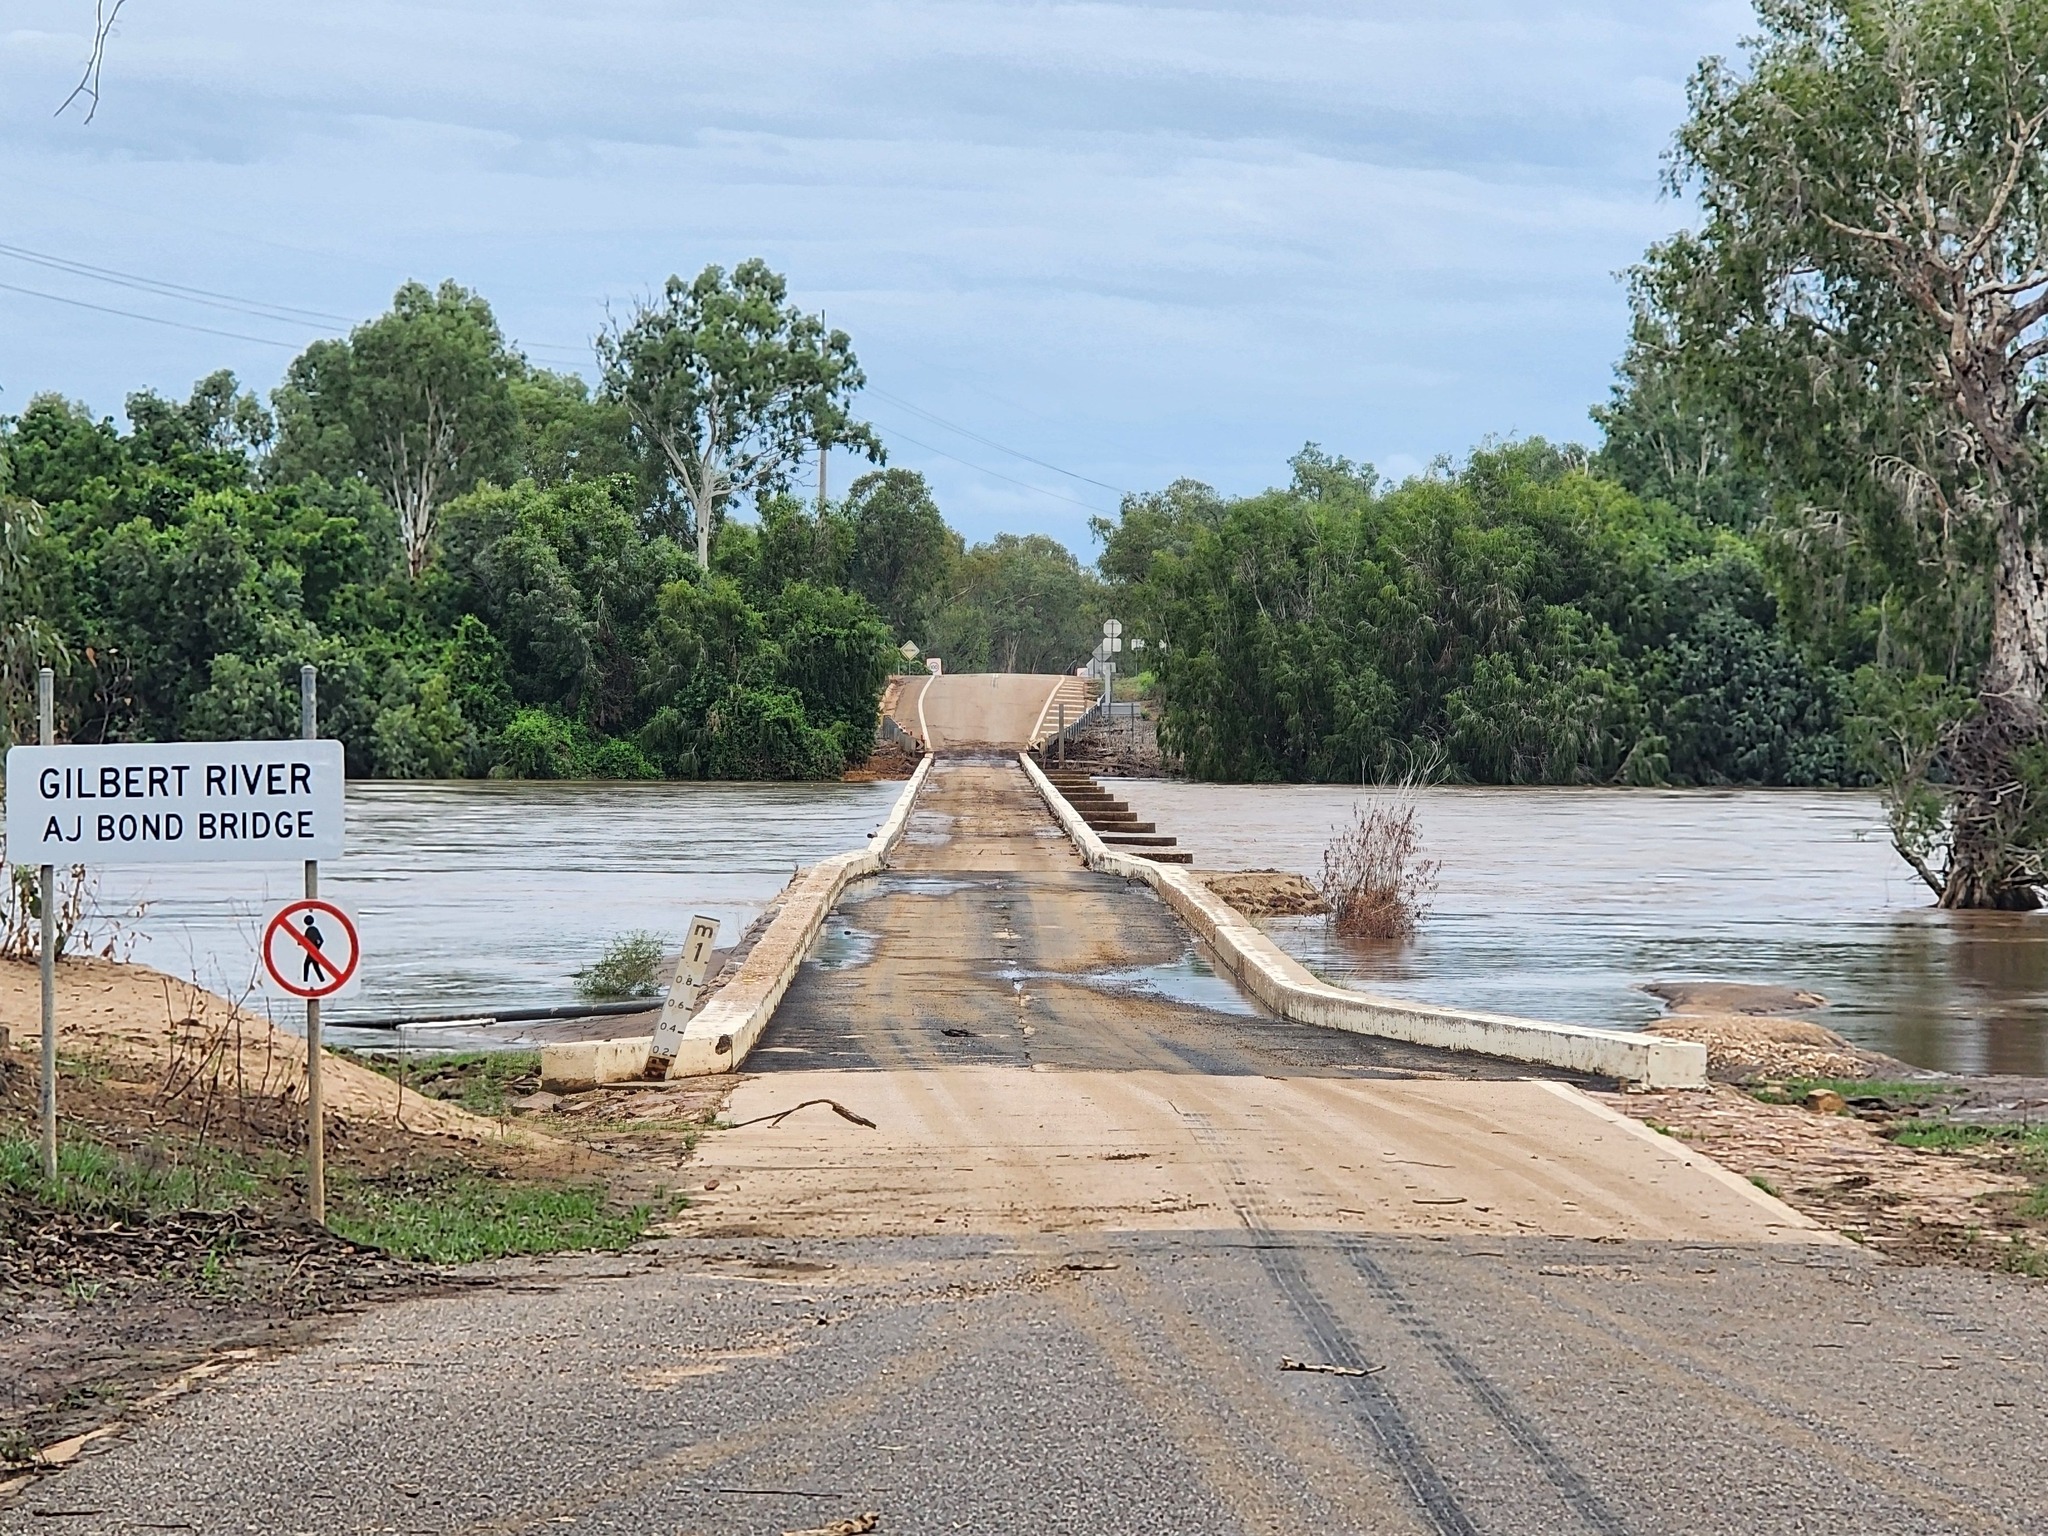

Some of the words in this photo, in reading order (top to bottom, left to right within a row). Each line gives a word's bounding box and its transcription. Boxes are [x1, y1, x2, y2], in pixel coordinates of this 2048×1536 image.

[39, 765, 190, 799] GILBERT
[206, 763, 312, 796] RIVER
[43, 815, 82, 842] AJ
[97, 813, 183, 841] BOND
[199, 811, 315, 839] BRIDGE
[694, 924, 713, 938] m
[693, 942, 703, 962] 1
[675, 975, 692, 986] 0.8
[668, 999, 684, 1009] 0.6
[660, 1022, 676, 1032] 0.4
[652, 1045, 669, 1056] 0.2
